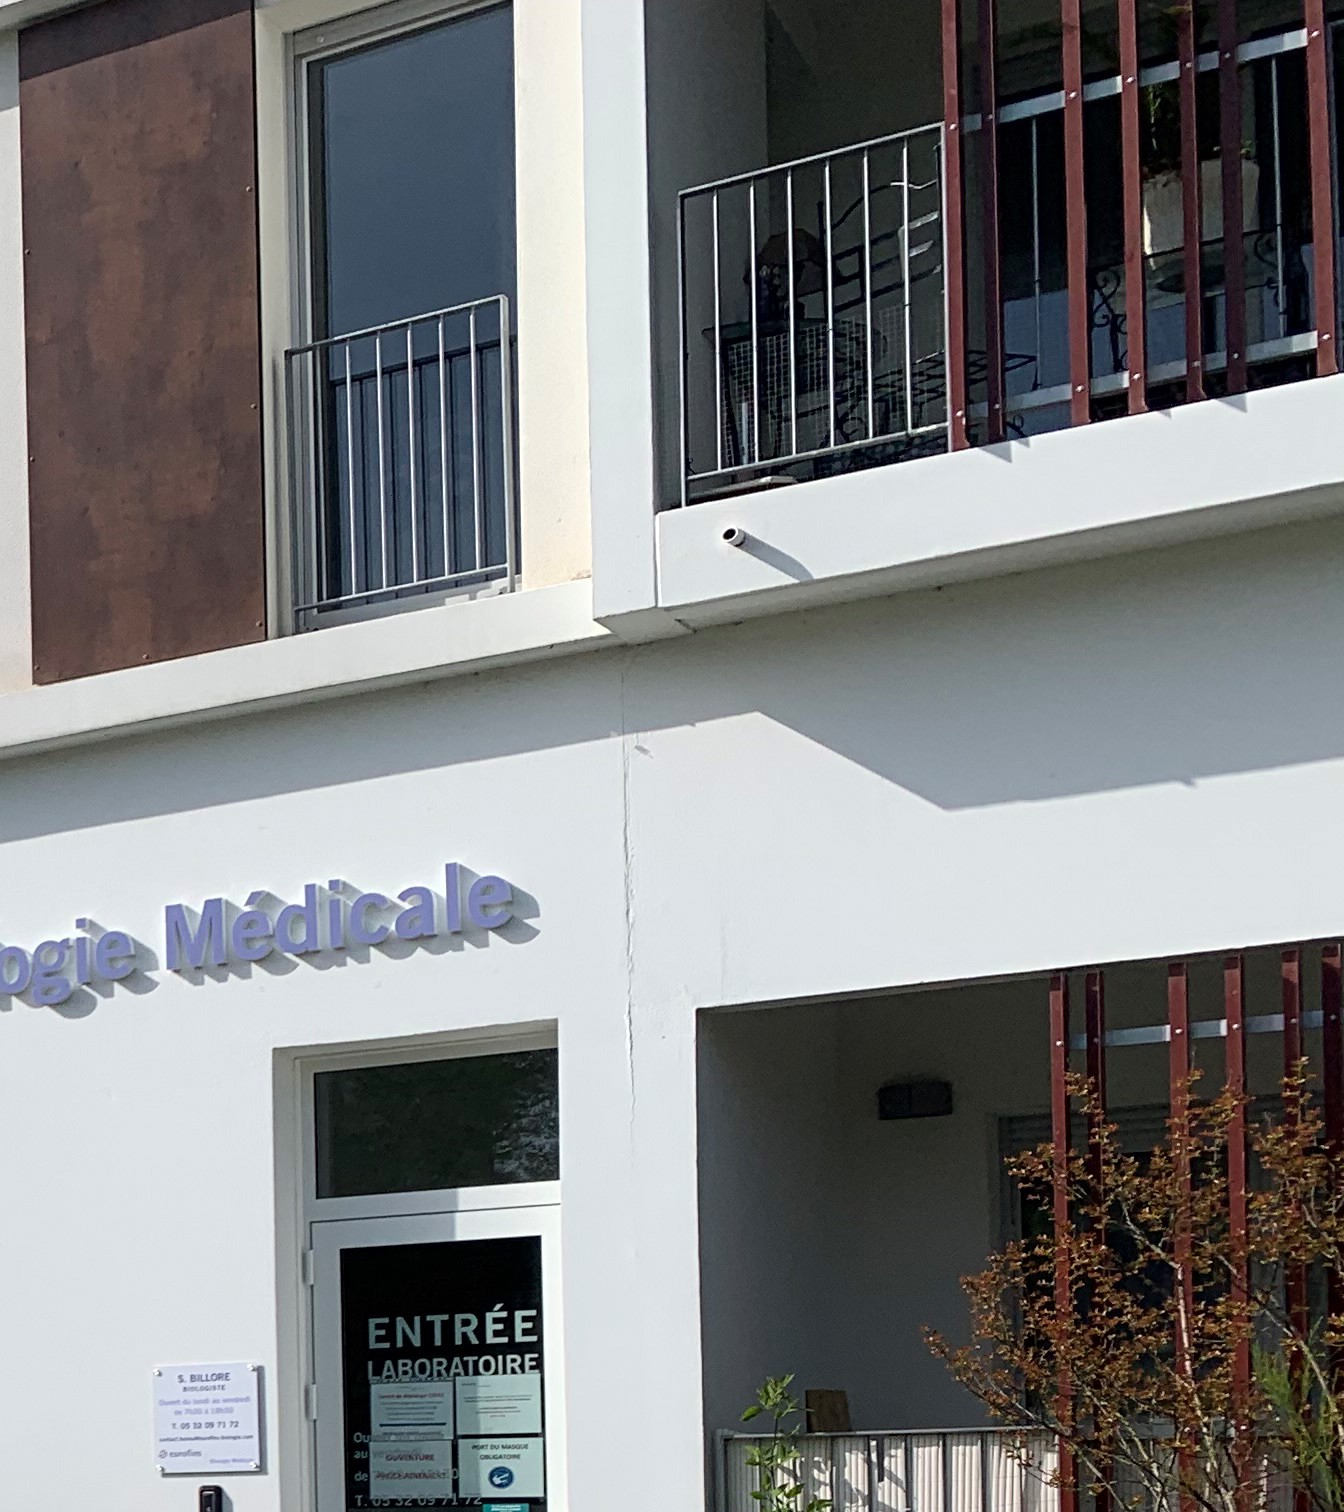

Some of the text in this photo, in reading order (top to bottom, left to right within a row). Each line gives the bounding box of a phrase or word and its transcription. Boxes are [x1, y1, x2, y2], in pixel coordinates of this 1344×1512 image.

[165, 862, 512, 973] Médicale
[368, 1303, 538, 1349] ENTRÉE
[368, 1353, 539, 1380] LABORATOIRE
